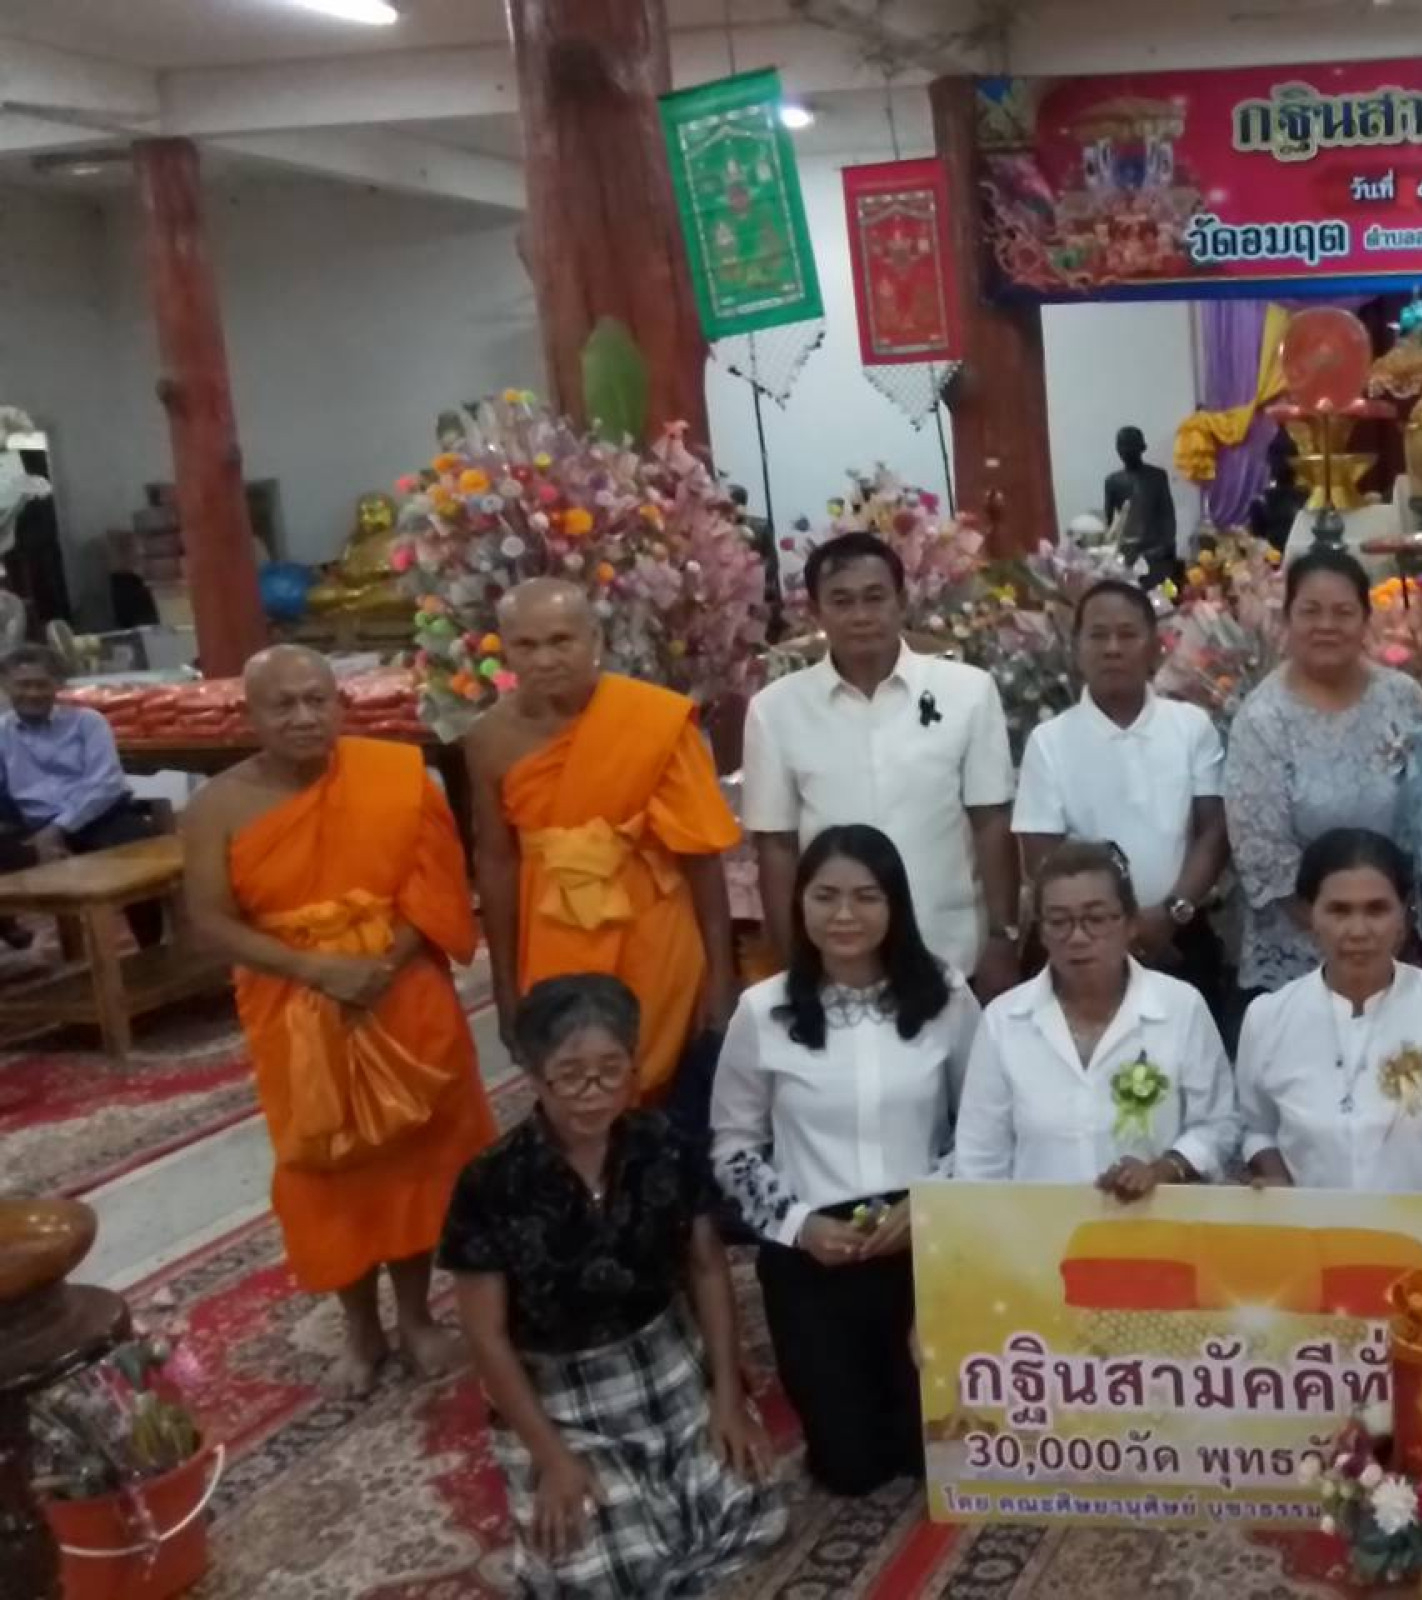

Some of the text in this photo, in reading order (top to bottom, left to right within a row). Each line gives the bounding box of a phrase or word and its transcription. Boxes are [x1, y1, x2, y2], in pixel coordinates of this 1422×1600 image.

[1351, 168, 1395, 200] วันที่
[1187, 215, 1347, 263] วัดอมฤต
[944, 1486, 989, 1511] โดย
